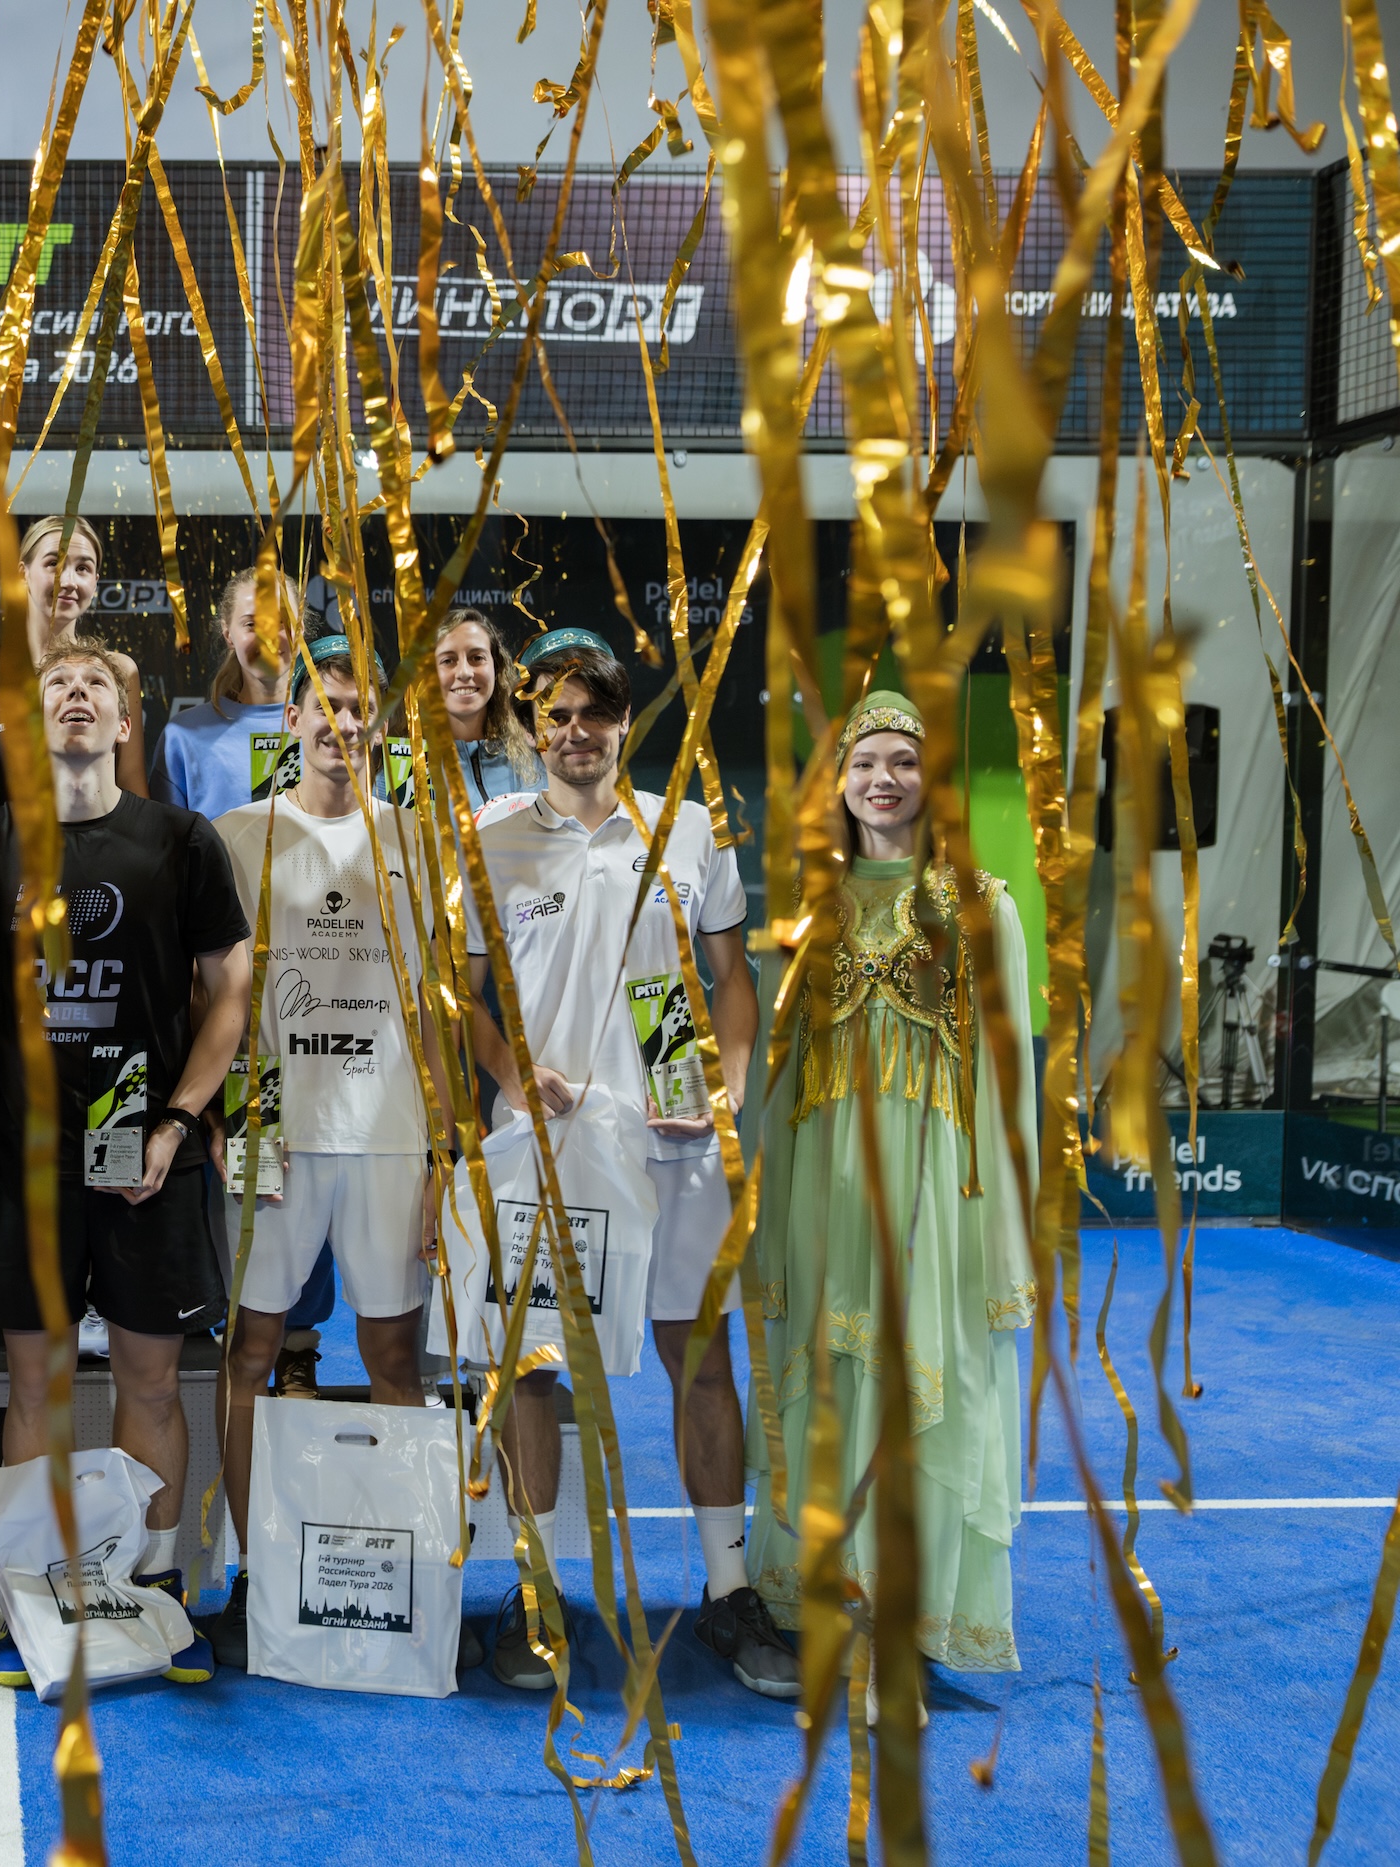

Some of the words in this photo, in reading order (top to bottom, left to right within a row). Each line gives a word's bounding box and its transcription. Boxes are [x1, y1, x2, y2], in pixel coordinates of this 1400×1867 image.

[307, 918, 364, 930] PADELIEN
[333, 1557, 365, 1567] турнир
[318, 1565, 376, 1578] Российского
[318, 1577, 347, 1588] Падел
[349, 1579, 369, 1590] Тура
[372, 1581, 394, 1591] 2026
[322, 1616, 347, 1626] ОГНИ
[349, 1618, 389, 1630] КАЗАНИ
